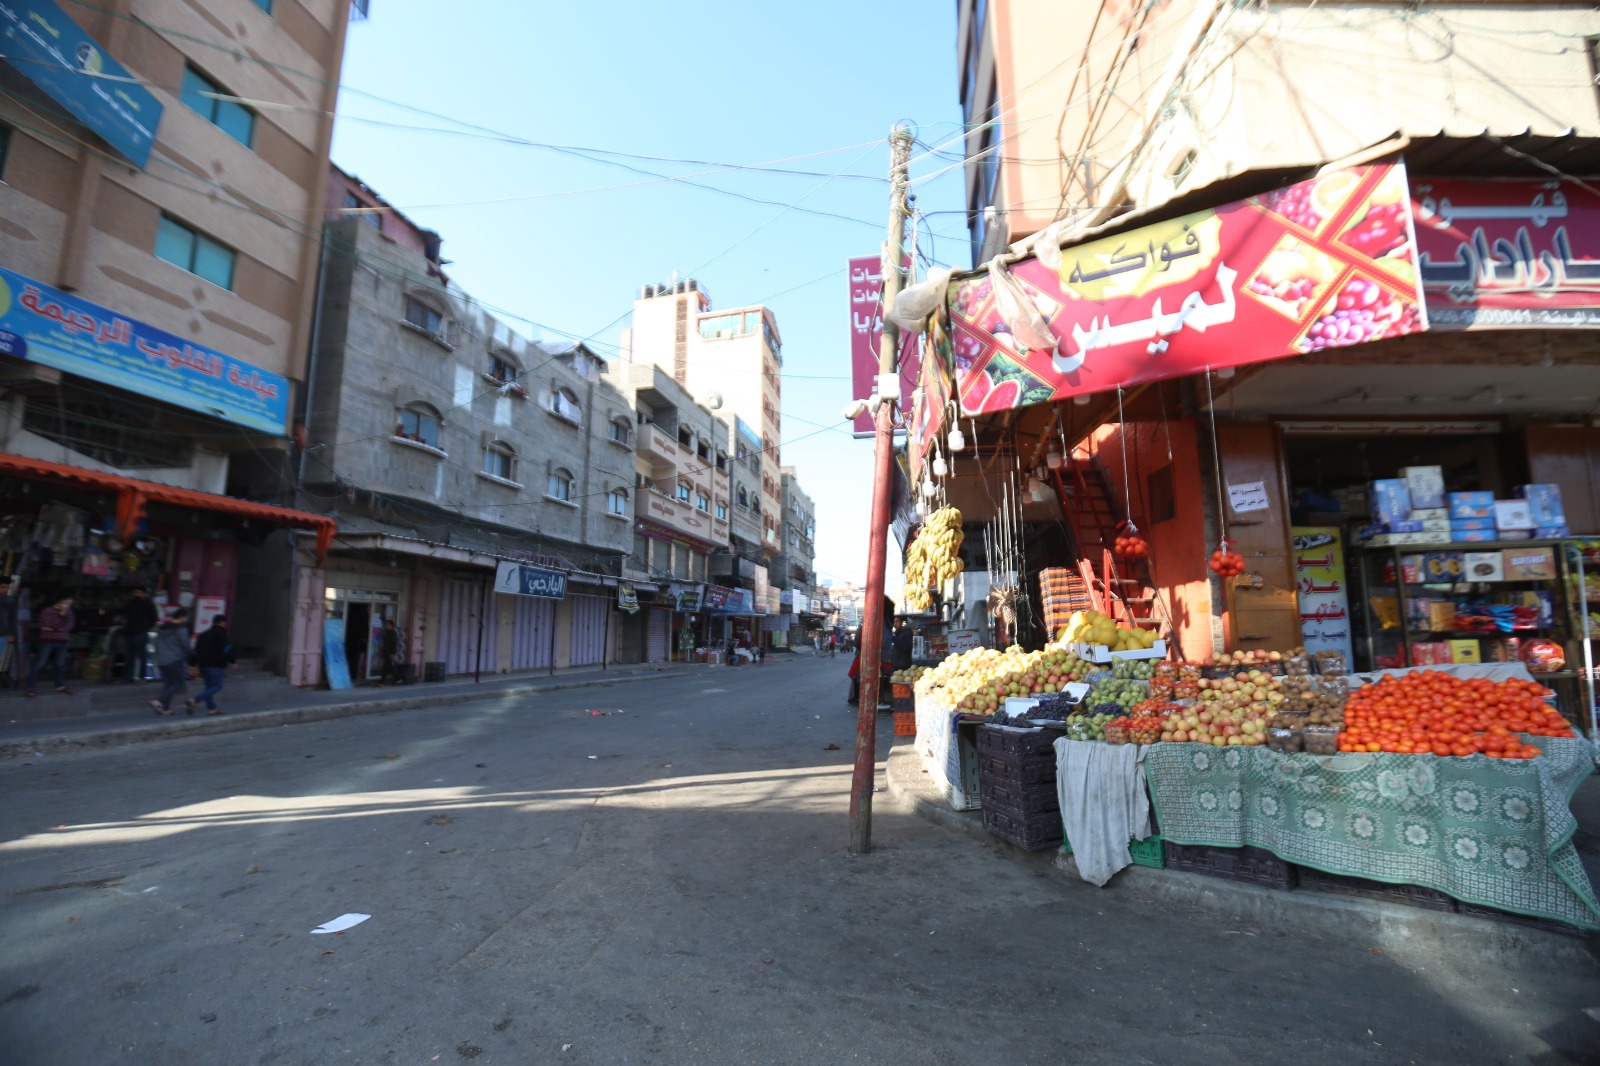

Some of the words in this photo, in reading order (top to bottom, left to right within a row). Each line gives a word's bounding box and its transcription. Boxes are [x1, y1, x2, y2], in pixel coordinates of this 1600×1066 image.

[1416, 182, 1569, 229] قهوة
[1068, 224, 1201, 284] فواكه
[19, 283, 132, 347] الرحيمة
[1051, 260, 1239, 374] لميس
[136, 337, 223, 379] القلوب
[226, 363, 279, 400] عيادة
[528, 574, 564, 595] اليازجي
